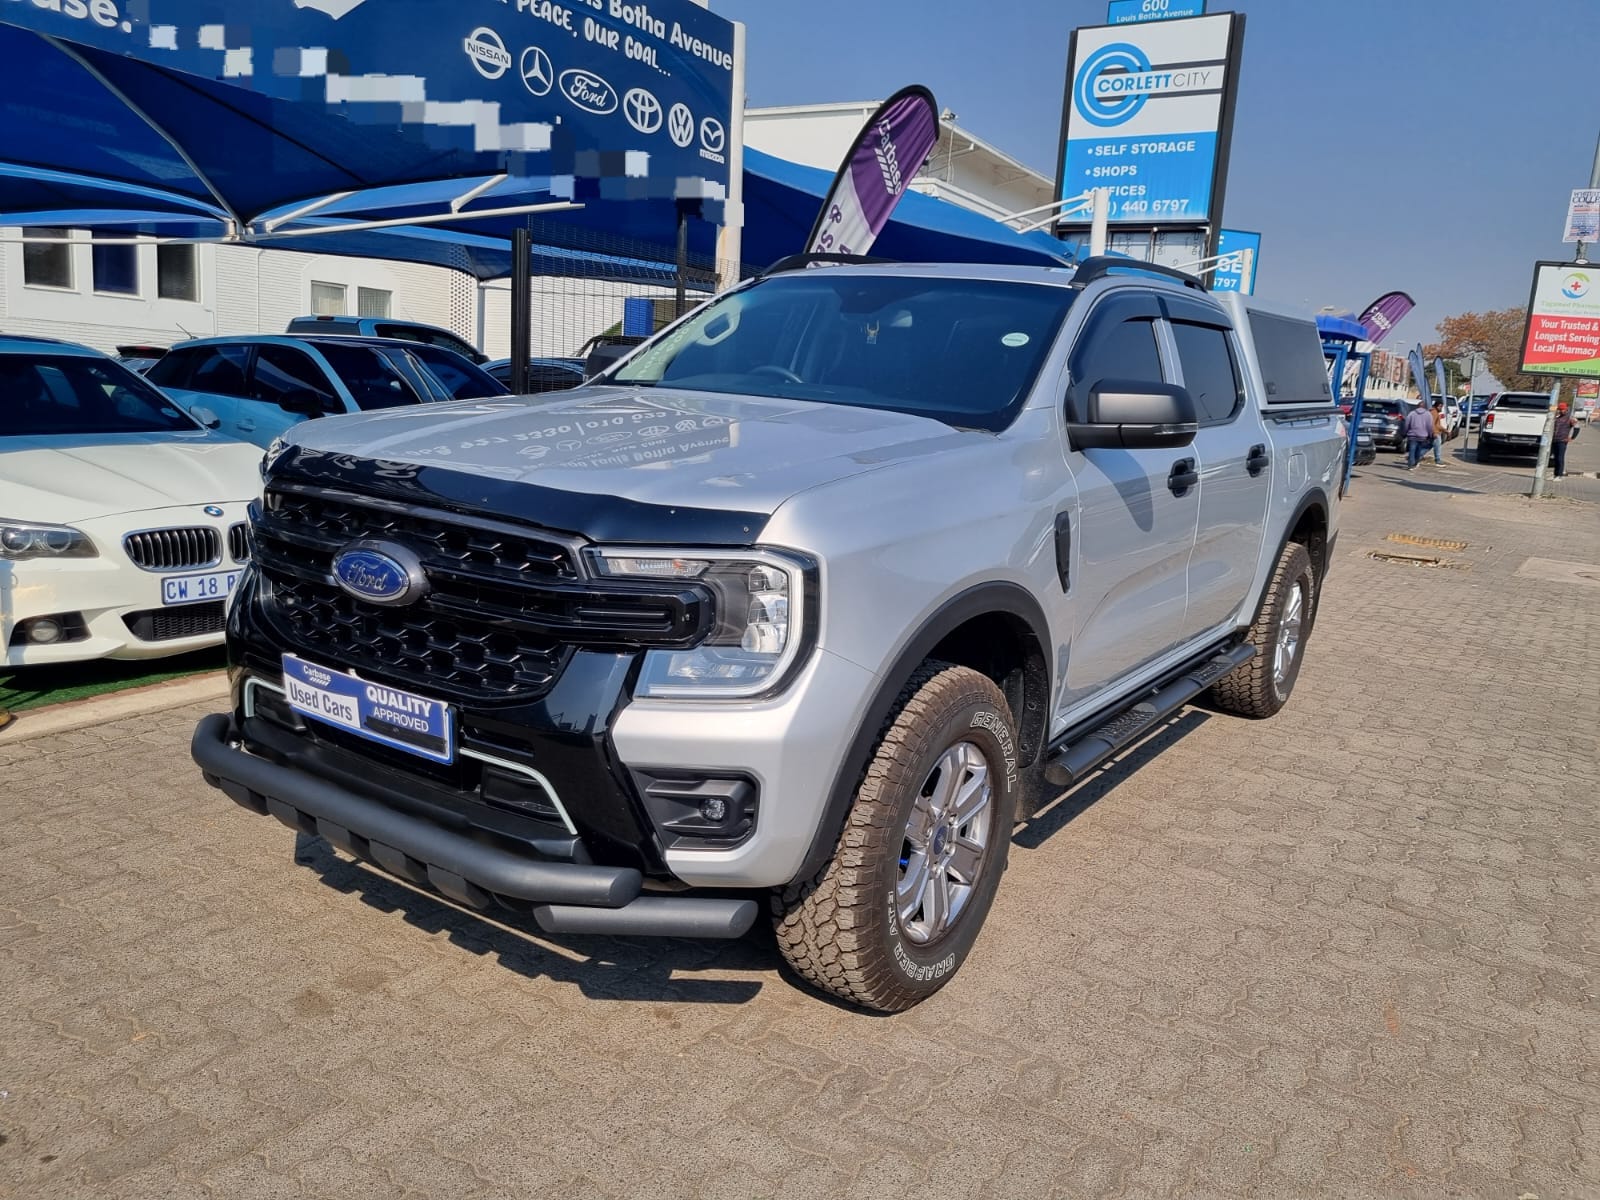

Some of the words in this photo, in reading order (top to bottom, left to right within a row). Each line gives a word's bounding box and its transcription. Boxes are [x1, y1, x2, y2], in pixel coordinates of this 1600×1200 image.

[1116, 14, 1136, 23] Louis
[1138, 12, 1161, 20] Botha
[1163, 9, 1194, 18] Avenue
[1142, 0, 1169, 12] 600
[466, 40, 510, 66] NISSAN
[670, 22, 732, 70] Avenue
[570, 74, 607, 108] Ford
[1094, 143, 1127, 156] SELF
[1131, 140, 1196, 155] STORAGE
[1092, 165, 1137, 176] SHOPS
[1121, 200, 1148, 211] 440
[1152, 199, 1189, 212] 6797
[1541, 319, 1558, 329] Your
[1560, 320, 1591, 331] Trusted
[1591, 322, 1599, 331] &
[1533, 342, 1555, 353] Local
[1556, 344, 1597, 357] Pharmacy
[1535, 331, 1567, 342] Longest
[1569, 333, 1600, 345] Serving
[346, 559, 389, 592] Ford
[166, 581, 188, 600] CW
[198, 577, 218, 597] 18
[303, 665, 331, 682] Carbase
[289, 682, 319, 712] Used
[322, 694, 353, 722] Cars
[366, 686, 431, 717] QUALITY
[373, 706, 429, 732] APPROVED
[970, 711, 1018, 792] GENERAL
[894, 942, 955, 981] GRABBER
